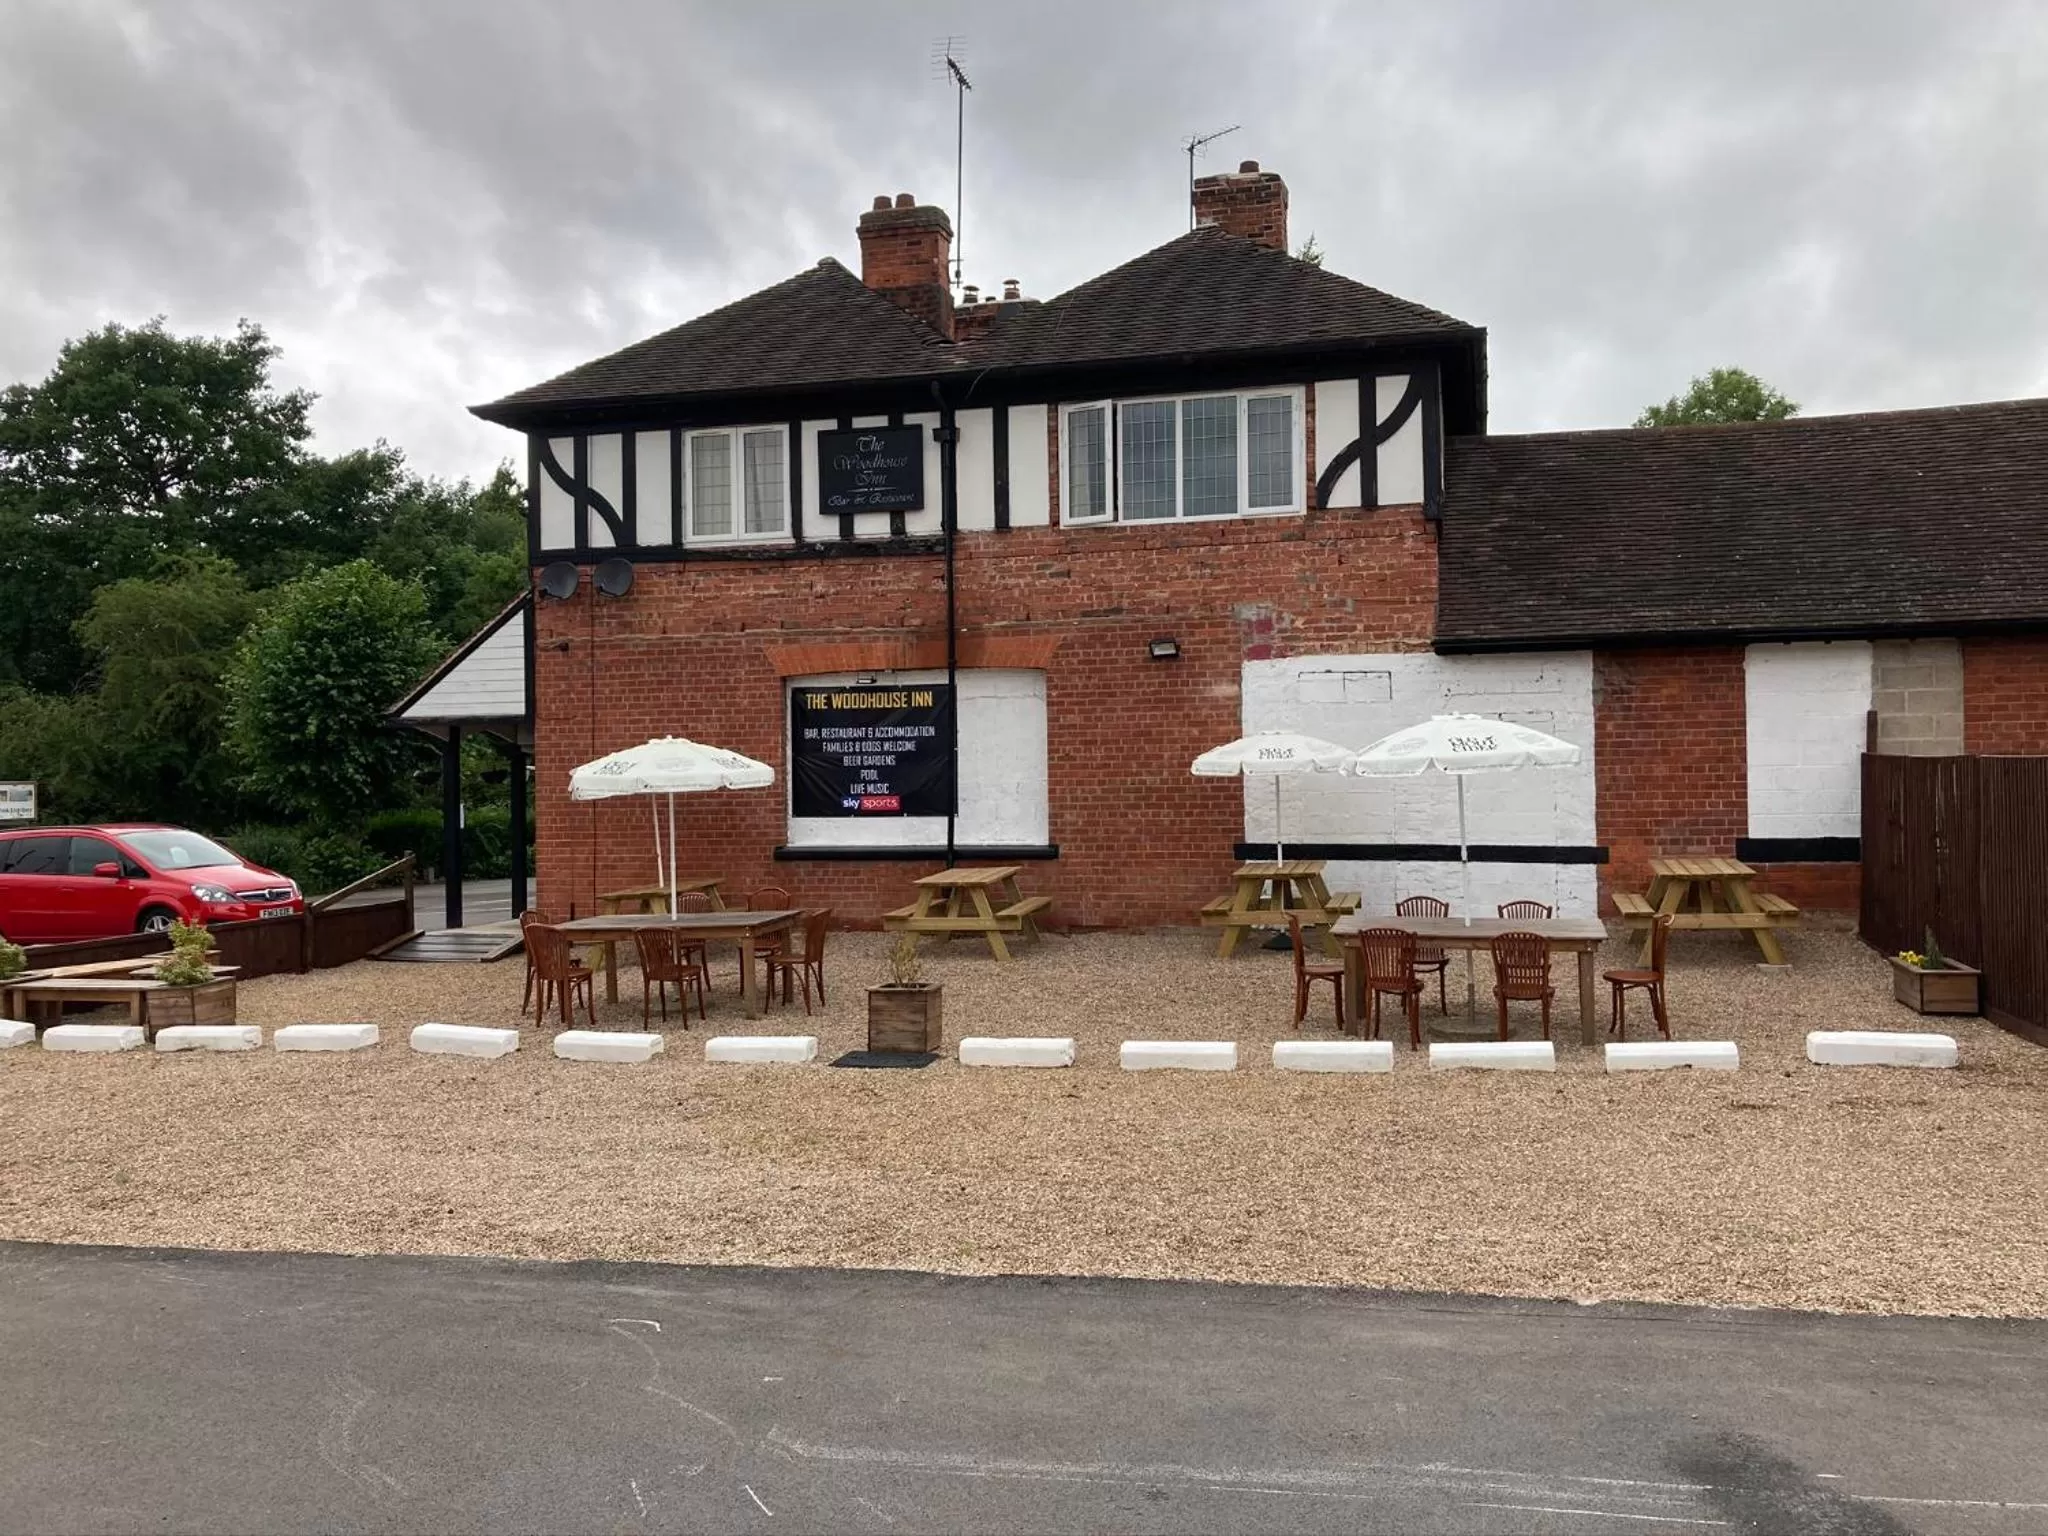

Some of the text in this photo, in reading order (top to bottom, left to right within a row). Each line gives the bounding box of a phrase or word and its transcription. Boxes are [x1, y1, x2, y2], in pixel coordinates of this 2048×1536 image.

[856, 435, 885, 452] The
[806, 691, 933, 710] THE WOODHOUSE INN
[804, 726, 935, 739] BAR, RESTAURANT & ACCOMMODATION
[822, 740, 917, 753] FAMILIES & DOGS WELCOME
[843, 755, 896, 766] BEER GARDENS
[860, 769, 879, 780] POOL
[850, 783, 890, 794] LIVE MUSIC
[843, 798, 898, 810] sky sports
